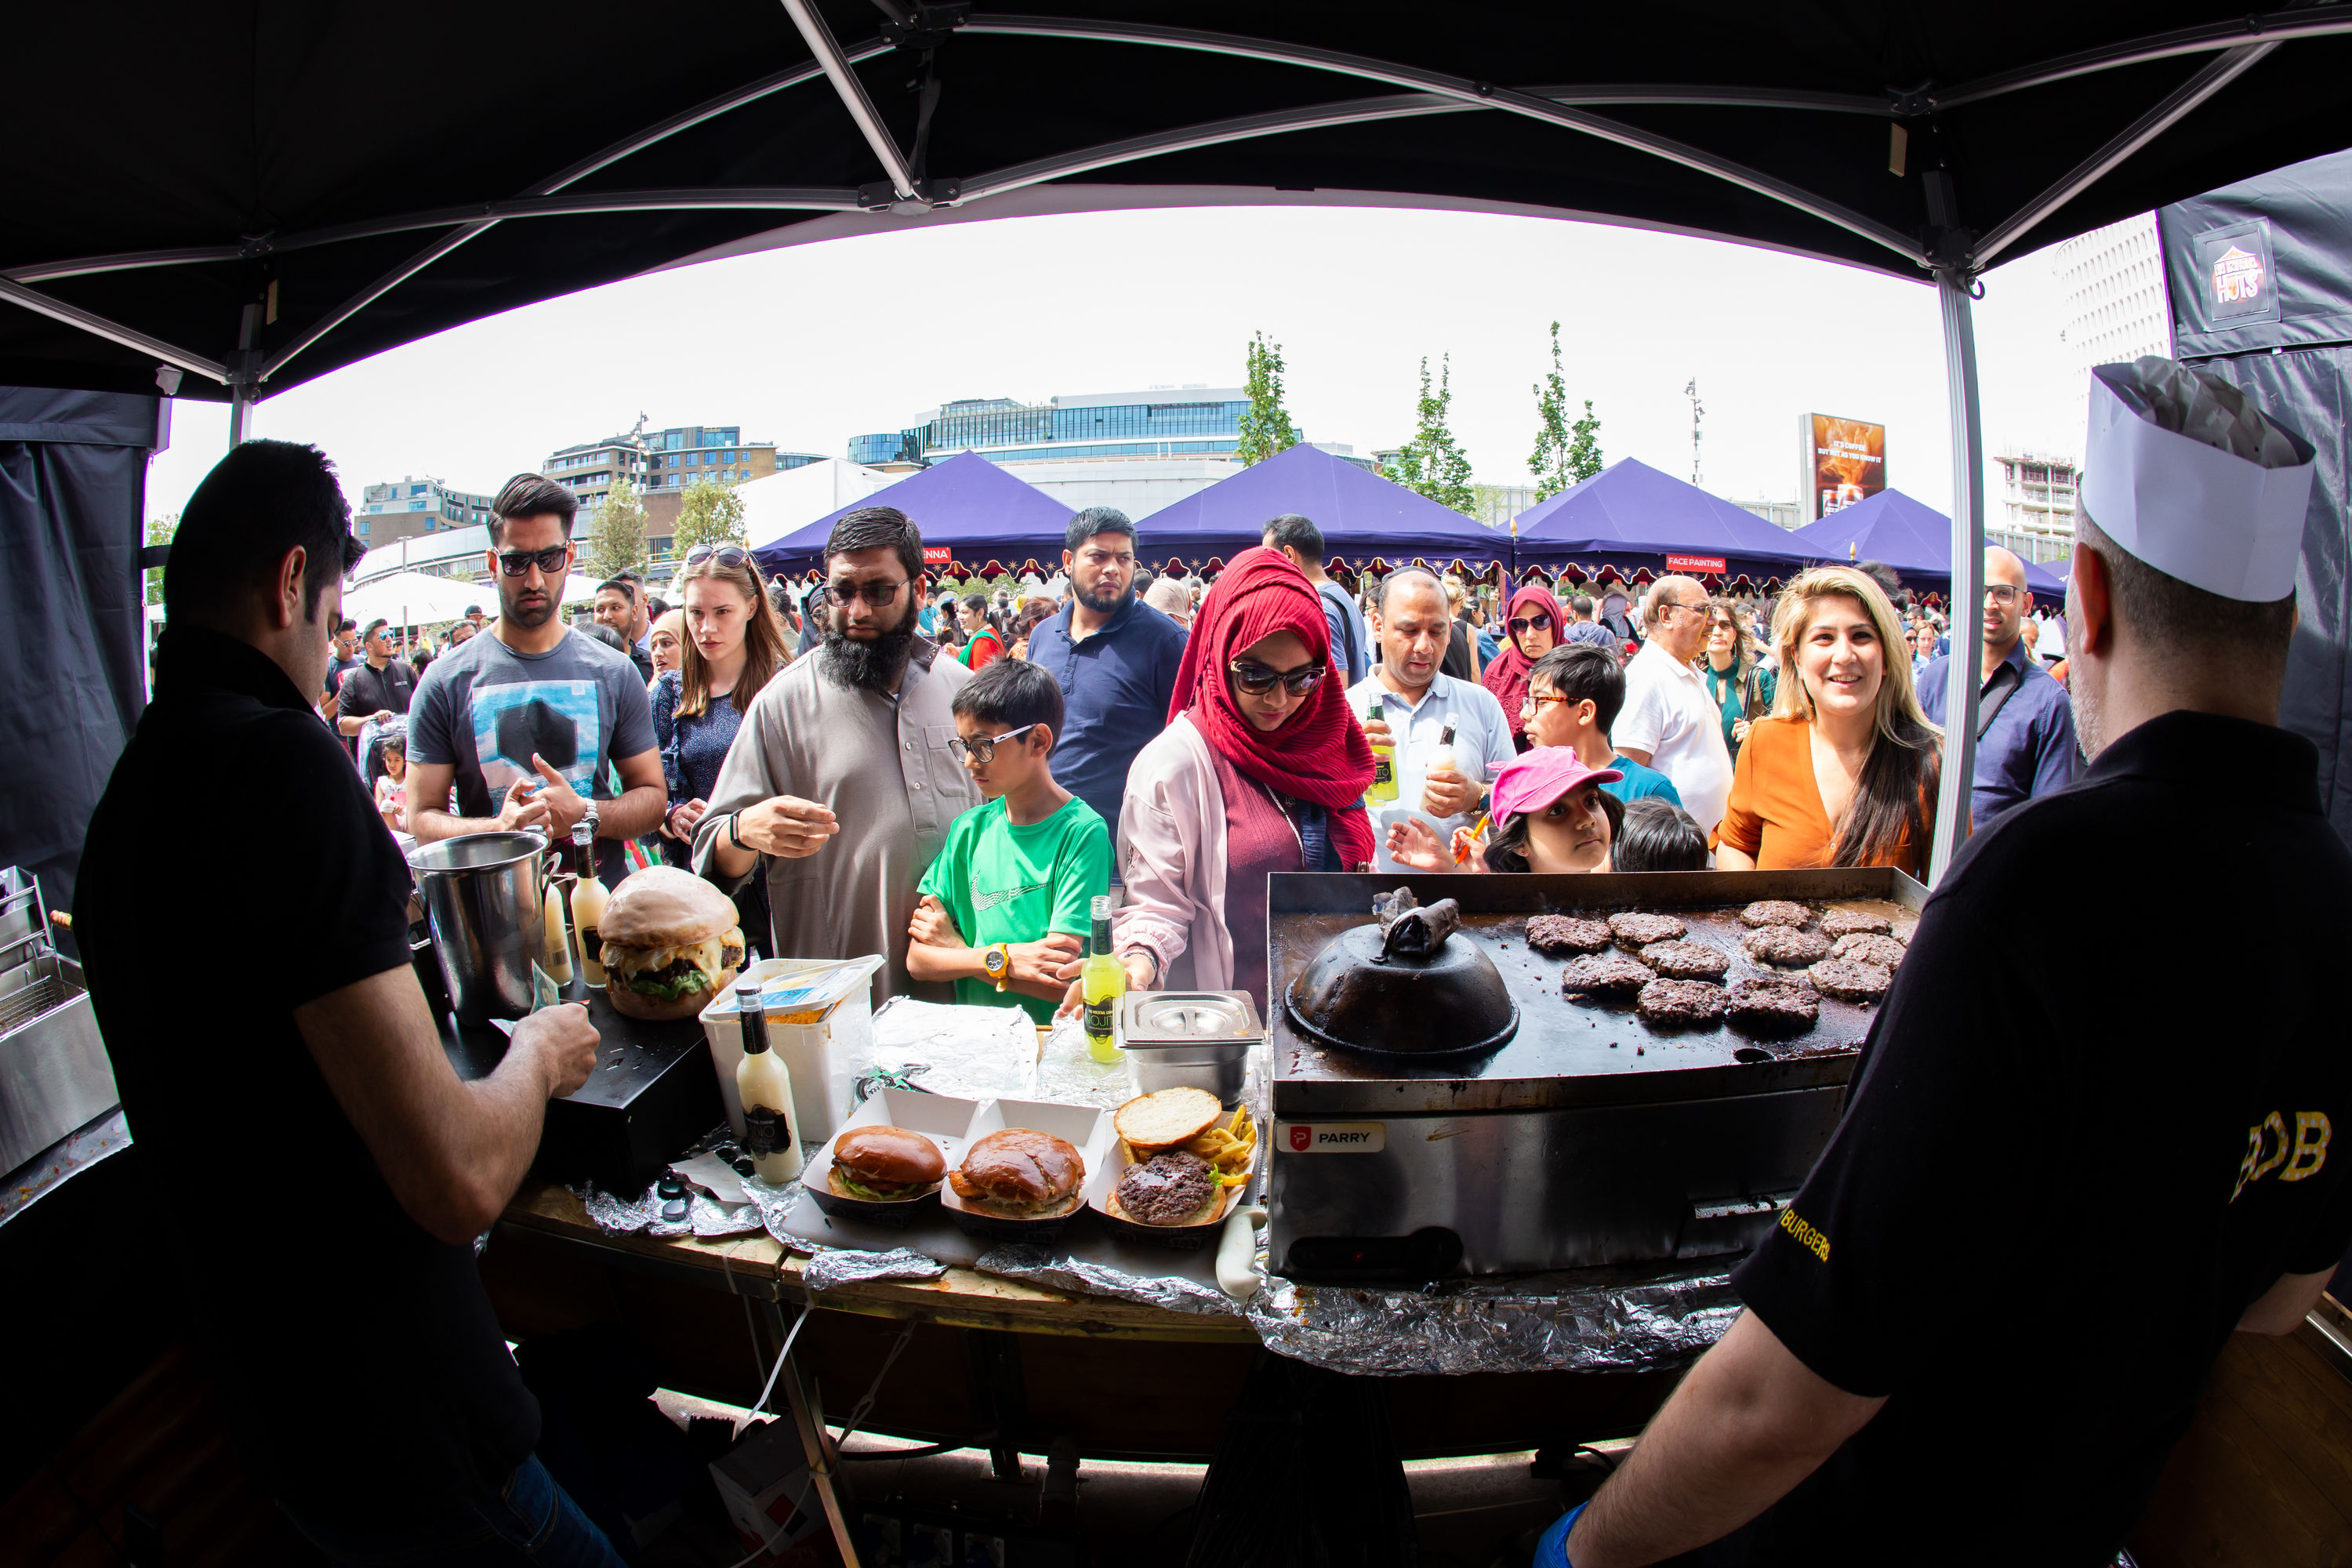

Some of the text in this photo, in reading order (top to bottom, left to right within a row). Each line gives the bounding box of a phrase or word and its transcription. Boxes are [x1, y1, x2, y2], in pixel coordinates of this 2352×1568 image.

[2216, 270, 2259, 303] HUTS
[1833, 440, 1866, 452] IT'S COFFEE
[1817, 447, 1828, 456] BUT
[1829, 448, 1841, 457] NOT
[1849, 452, 1860, 460] YOU
[1860, 454, 1876, 463] KNOW
[1689, 559, 1723, 568] PAINTING
[1319, 1132, 1370, 1143] PARRY
[1780, 1208, 1831, 1263] BURGERS
